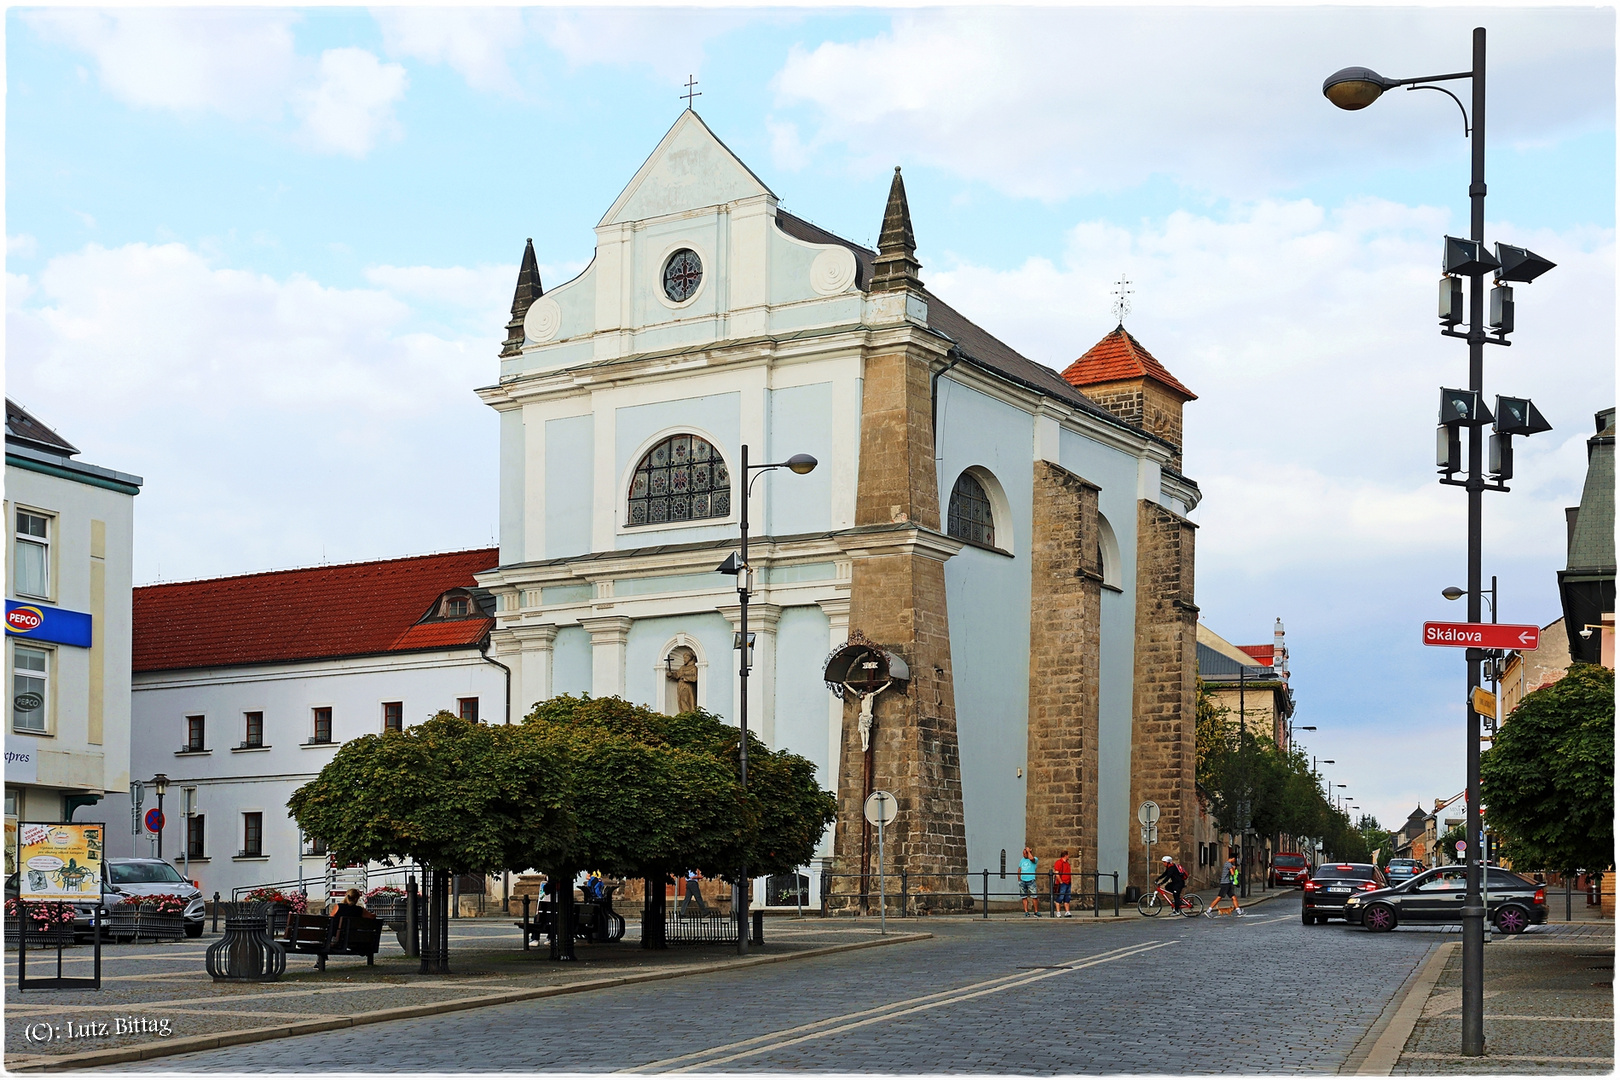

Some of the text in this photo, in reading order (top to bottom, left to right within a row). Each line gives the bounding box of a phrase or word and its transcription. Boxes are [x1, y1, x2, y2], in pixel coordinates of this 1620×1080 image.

[9, 613, 38, 626] PEPCO
[1426, 627, 1482, 642] Skálova
[16, 697, 39, 707] PEPCO
